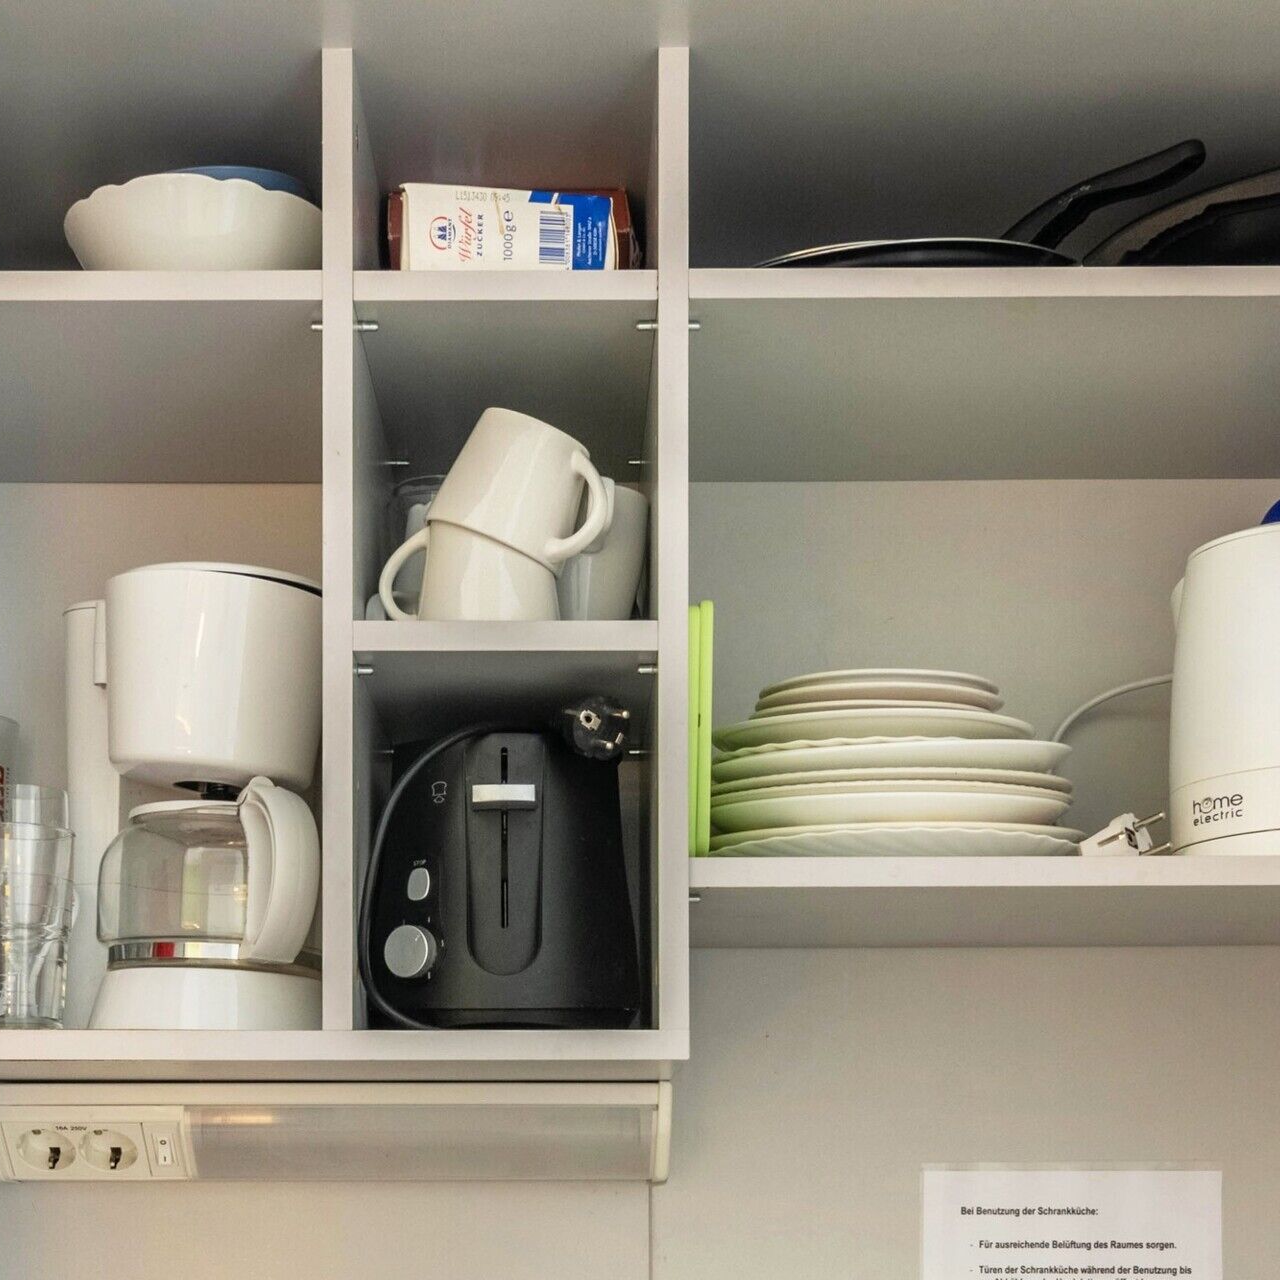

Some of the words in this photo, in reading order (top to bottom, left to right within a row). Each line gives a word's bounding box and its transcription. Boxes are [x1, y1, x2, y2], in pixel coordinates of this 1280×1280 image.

[458, 206, 476, 262] Würfel
[476, 214, 484, 257] ZUCKER
[1193, 794, 1243, 815] home
[1193, 808, 1243, 826] electric
[961, 1206, 974, 1215] Bei
[976, 1206, 1020, 1218] Benutzung
[1022, 1206, 1036, 1215] der
[1038, 1206, 1099, 1216] Schrankküche:
[979, 1240, 993, 1249] Für
[995, 1240, 1050, 1249] ausreichende
[1052, 1240, 1091, 1251] Belüftung
[1093, 1240, 1108, 1249] des
[1110, 1240, 1143, 1249] Raumes
[1145, 1241, 1177, 1251] sorgen.
[979, 1265, 1003, 1275] Türen
[1005, 1265, 1019, 1275] der
[1020, 1265, 1078, 1275] Schrankküche
[1080, 1265, 1115, 1275] während
[1117, 1265, 1131, 1275] der
[1133, 1265, 1177, 1277] Benutzung
[1179, 1265, 1192, 1275] bis
